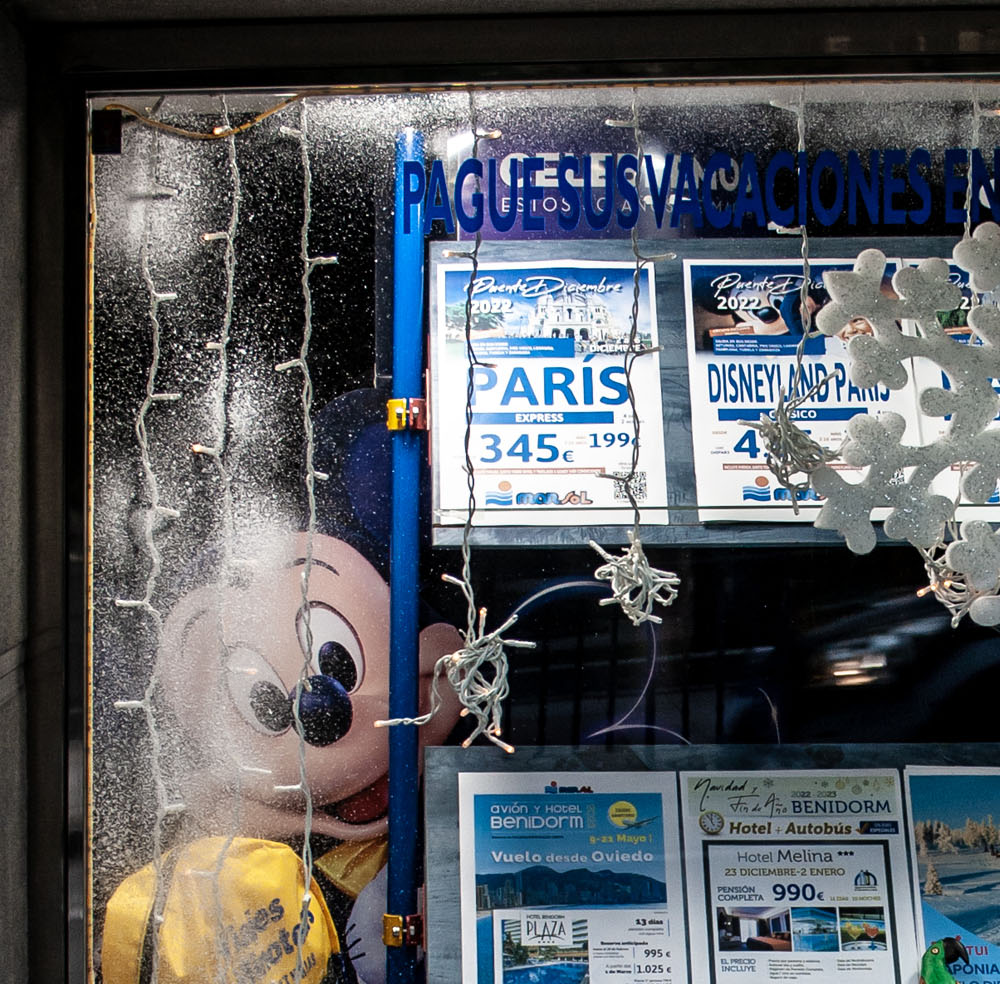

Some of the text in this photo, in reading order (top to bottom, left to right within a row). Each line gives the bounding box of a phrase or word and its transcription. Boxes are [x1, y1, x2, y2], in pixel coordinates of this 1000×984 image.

[403, 157, 546, 235] PAGUE
[556, 153, 640, 231] SUS
[643, 149, 929, 230] VACACIONES
[464, 275, 623, 297] Puente Diciembre
[710, 272, 774, 298] Puente
[471, 297, 512, 313] 2022
[717, 296, 760, 310] 2022
[467, 354, 631, 406] PARÍS
[707, 363, 829, 403] DISNEYLAND
[515, 413, 564, 423] EXPRESS
[769, 409, 817, 419] CSICO
[694, 778, 748, 811] Navidad
[791, 800, 892, 814] BENIDORM
[730, 821, 771, 834] Hotel
[785, 821, 852, 835] Autobús
[616, 834, 647, 844] Mayo
[491, 850, 654, 863] Vuelo desde Oviedo
[737, 849, 833, 863] Hotel Melina
[724, 868, 737, 877] 23
[809, 868, 846, 876] ENERO
[717, 885, 755, 894] PENSIÓN
[772, 883, 824, 902] 990€
[717, 894, 764, 902] COMPLETA
[526, 921, 566, 940] PLAZA
[644, 949, 663, 958] 995
[636, 965, 663, 974] 1.025
